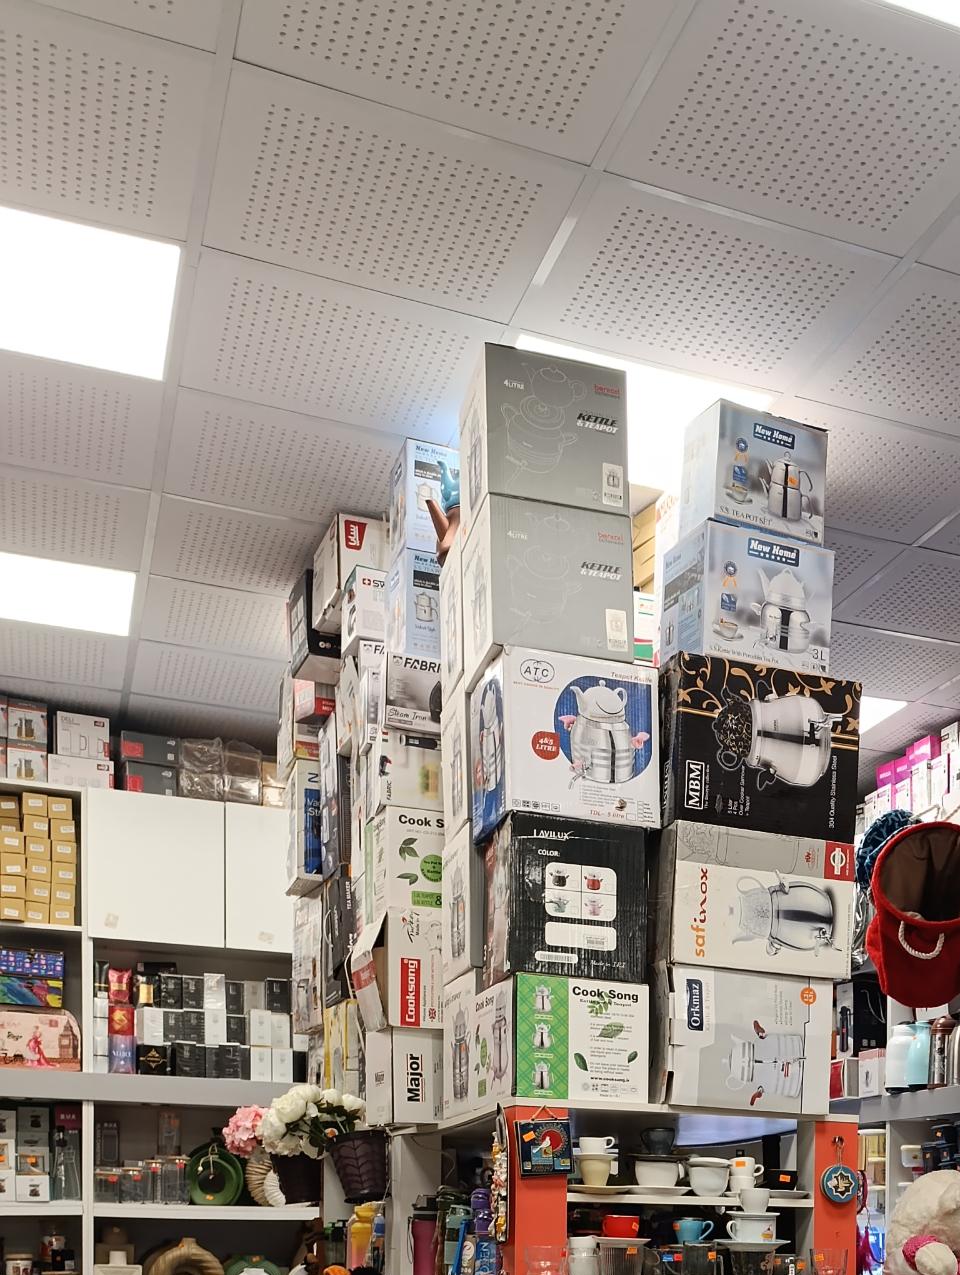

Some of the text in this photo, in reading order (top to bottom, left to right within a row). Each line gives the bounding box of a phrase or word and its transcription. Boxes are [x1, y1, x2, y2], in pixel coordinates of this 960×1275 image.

[577, 412, 617, 427] KETTLE
[584, 421, 619, 434] TEAPOT
[754, 424, 770, 437] New
[748, 541, 796, 560] New Home
[580, 561, 621, 575] KETTLE
[587, 571, 622, 581] TEAPOT
[812, 646, 825, 659] 3L
[524, 664, 549, 677] ATC
[412, 712, 428, 721] Iron
[687, 762, 702, 807] MBM
[398, 814, 431, 827] Cook
[533, 829, 570, 841] LAVILUX
[691, 867, 708, 957] safinox
[404, 960, 419, 1022] Cooksong
[572, 985, 639, 1004] Cook Song
[689, 982, 701, 1027] Orkmaz
[407, 1053, 423, 1102] Major
